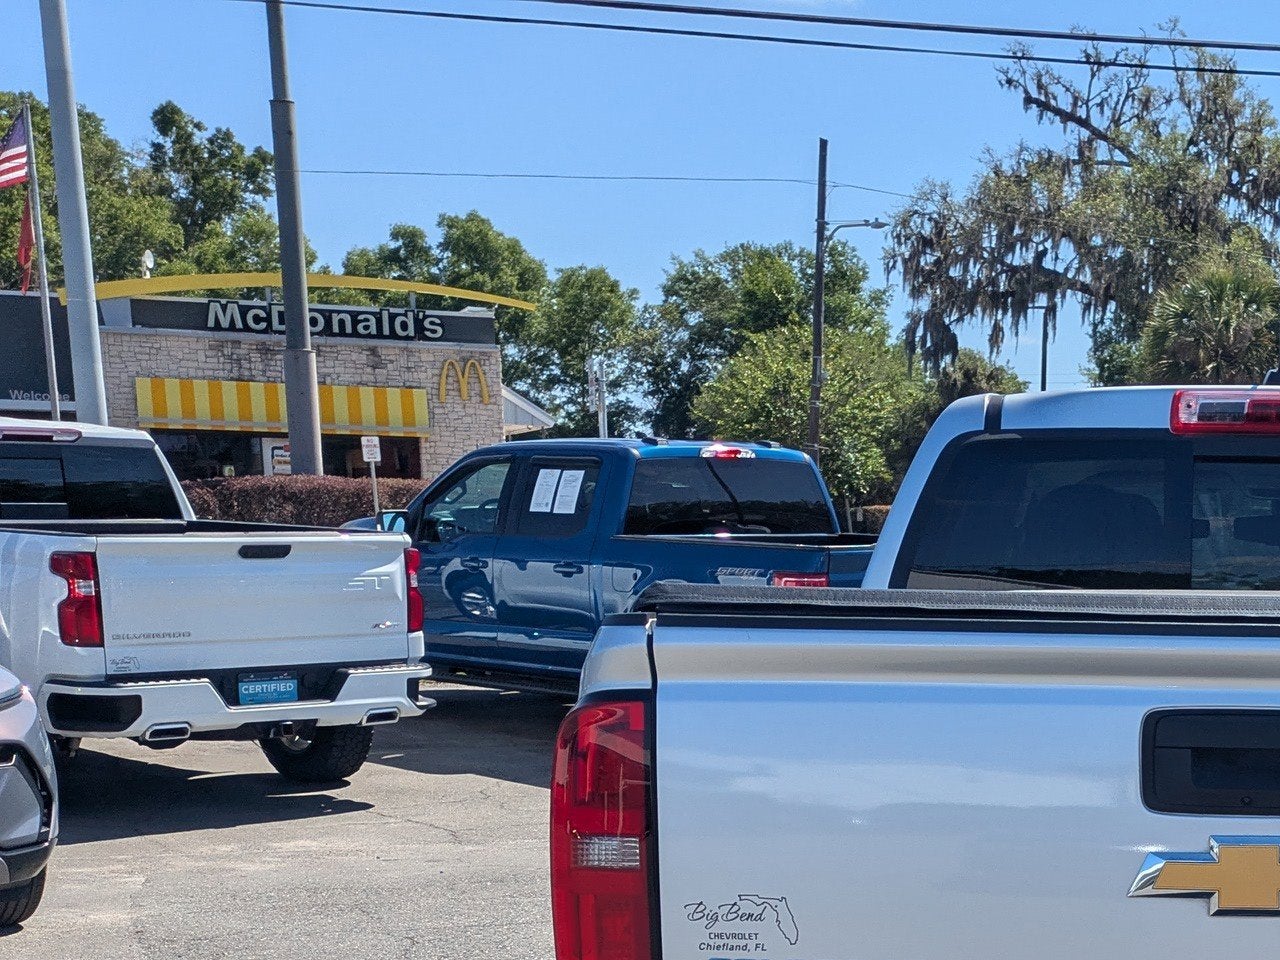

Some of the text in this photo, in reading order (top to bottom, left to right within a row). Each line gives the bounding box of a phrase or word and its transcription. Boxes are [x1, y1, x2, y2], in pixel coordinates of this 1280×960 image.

[9, 389, 70, 401] Welcoe
[715, 566, 764, 577] SPORT
[241, 682, 295, 694] CERTIFIED
[684, 901, 767, 929] Big Bend
[708, 932, 759, 941] CHEVROLET
[698, 942, 768, 953] Chiefland, FL
